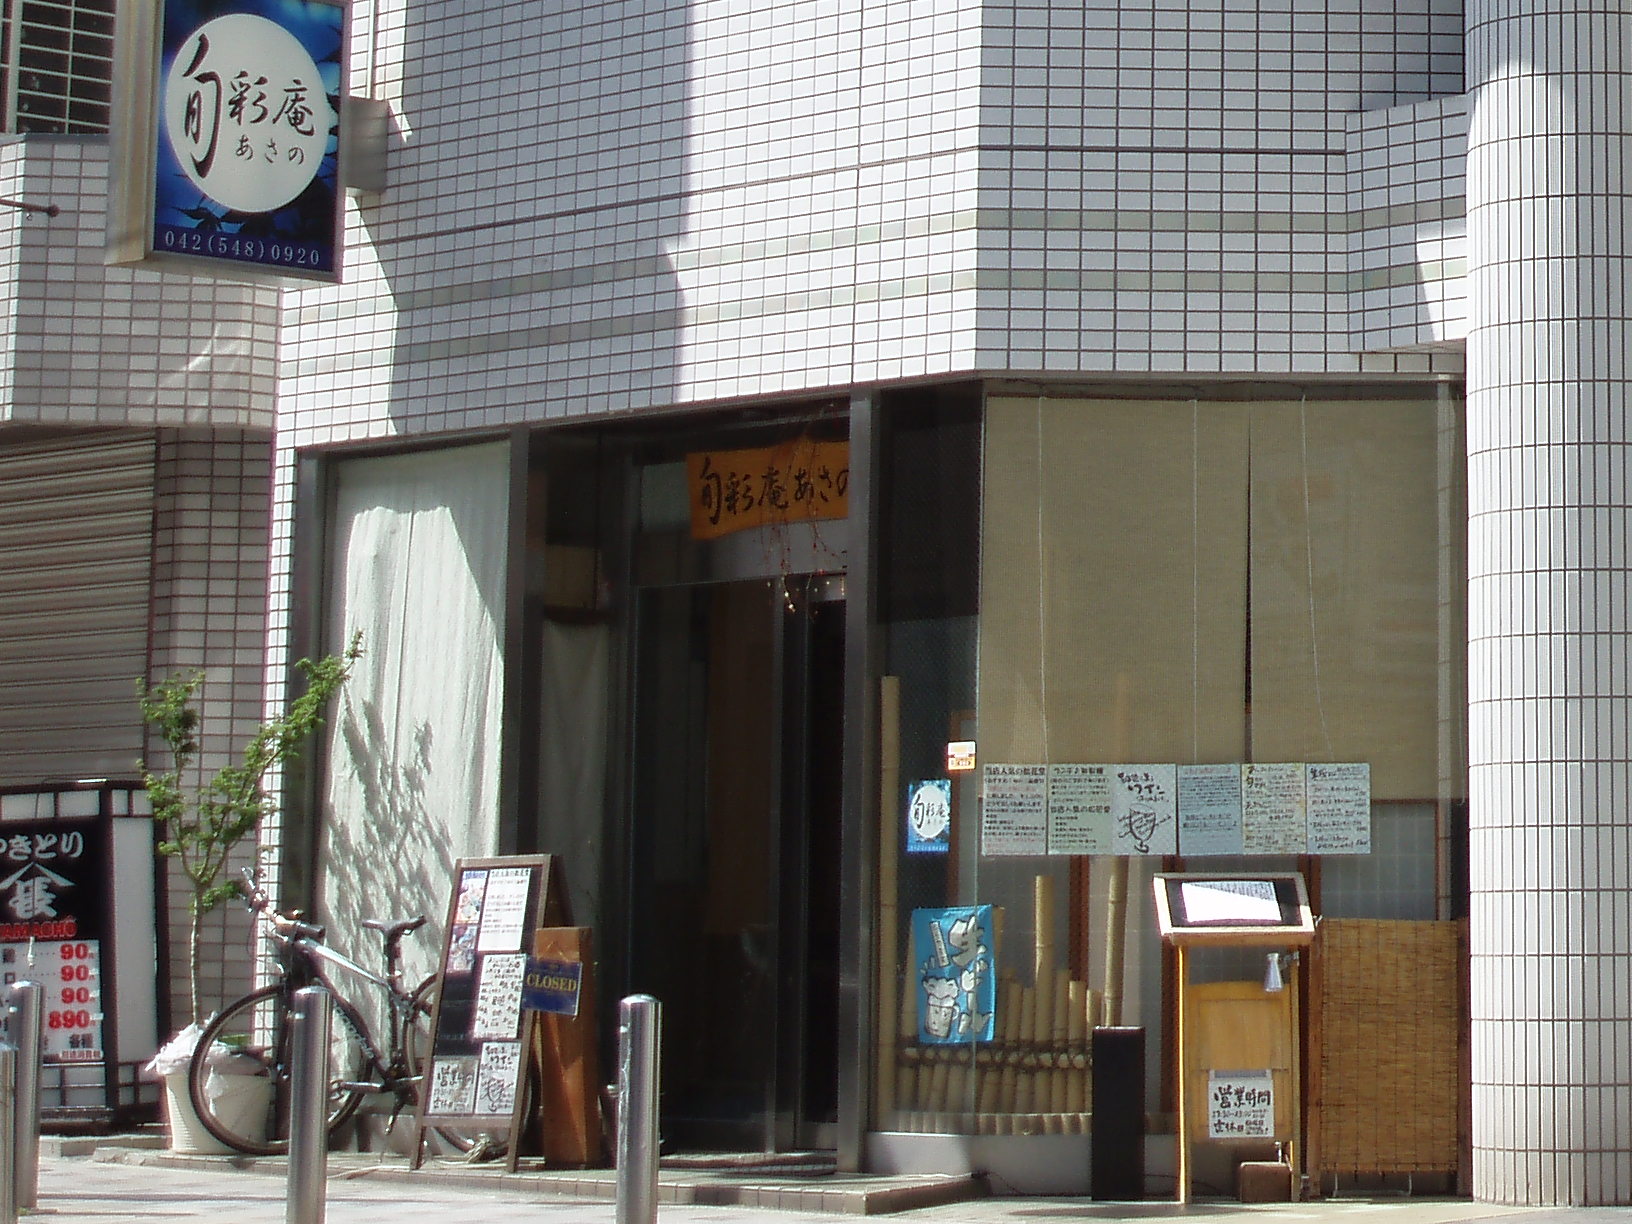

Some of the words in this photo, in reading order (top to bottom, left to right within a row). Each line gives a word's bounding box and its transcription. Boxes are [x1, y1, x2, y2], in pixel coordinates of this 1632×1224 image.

[235, 133, 305, 166] あさの
[164, 229, 320, 266] 042(548)0920
[526, 973, 577, 992] CLOSED
